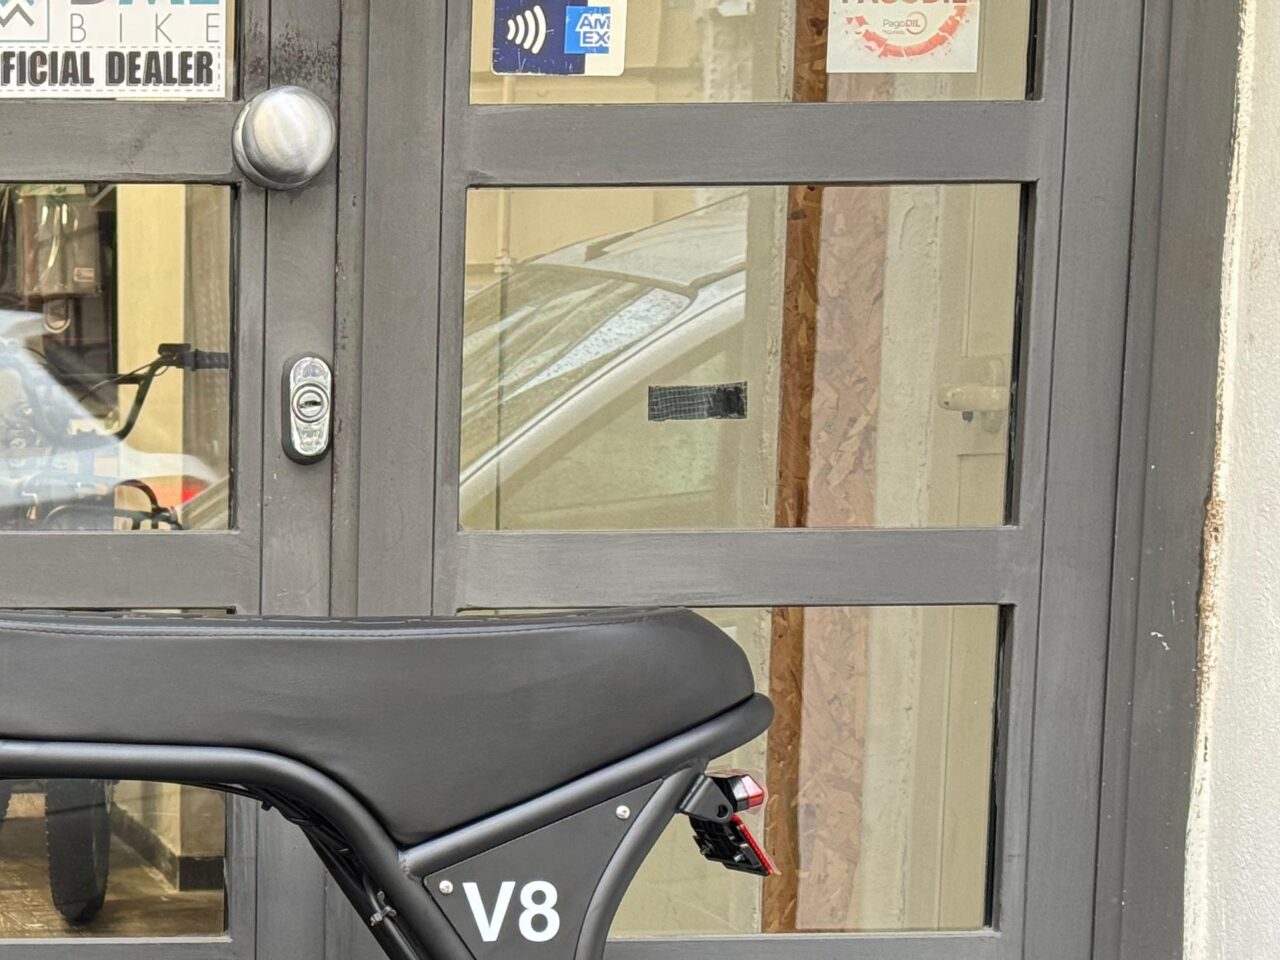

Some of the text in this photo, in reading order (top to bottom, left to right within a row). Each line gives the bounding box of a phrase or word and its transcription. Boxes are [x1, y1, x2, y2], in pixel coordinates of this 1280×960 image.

[70, 13, 220, 43] BIKE
[106, 50, 213, 87] DEALER
[462, 880, 560, 943] V8
